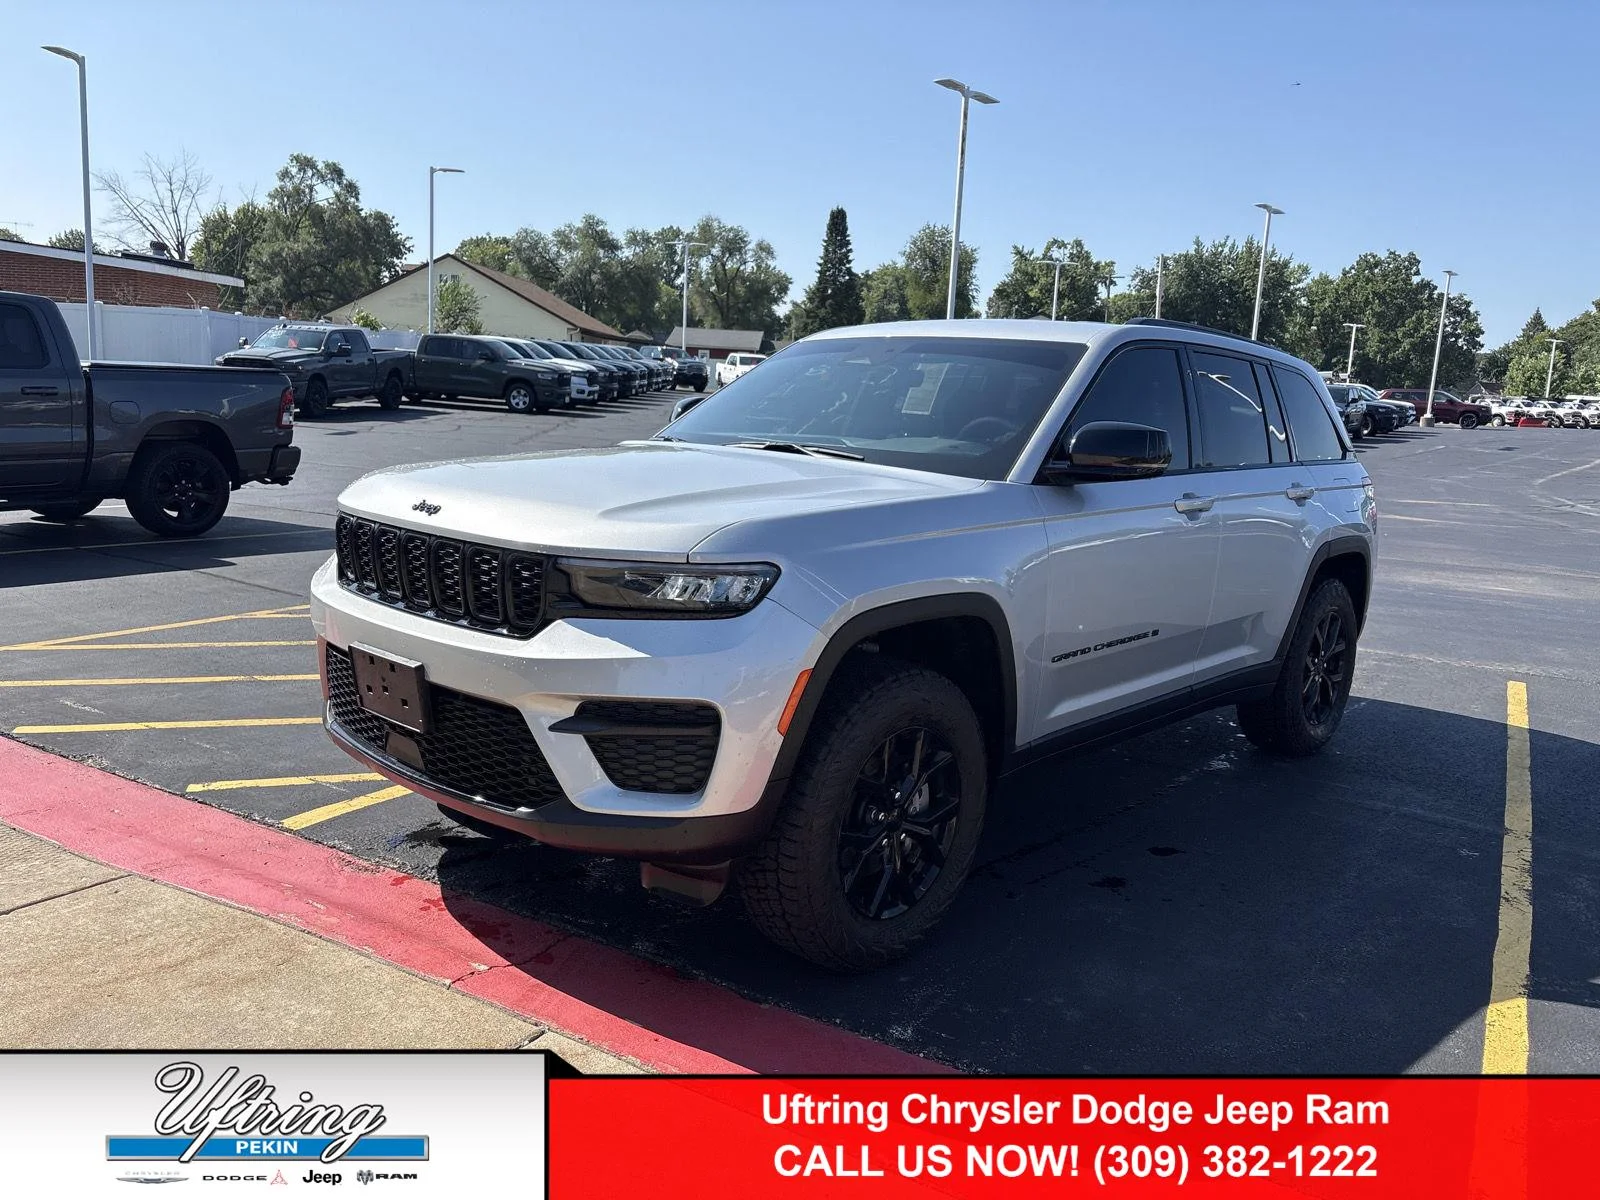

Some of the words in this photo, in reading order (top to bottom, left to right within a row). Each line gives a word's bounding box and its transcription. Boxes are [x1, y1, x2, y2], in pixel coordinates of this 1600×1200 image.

[411, 499, 442, 516] Jeep
[1051, 646, 1092, 663] GRAND
[1093, 631, 1150, 652] CHEROKEE
